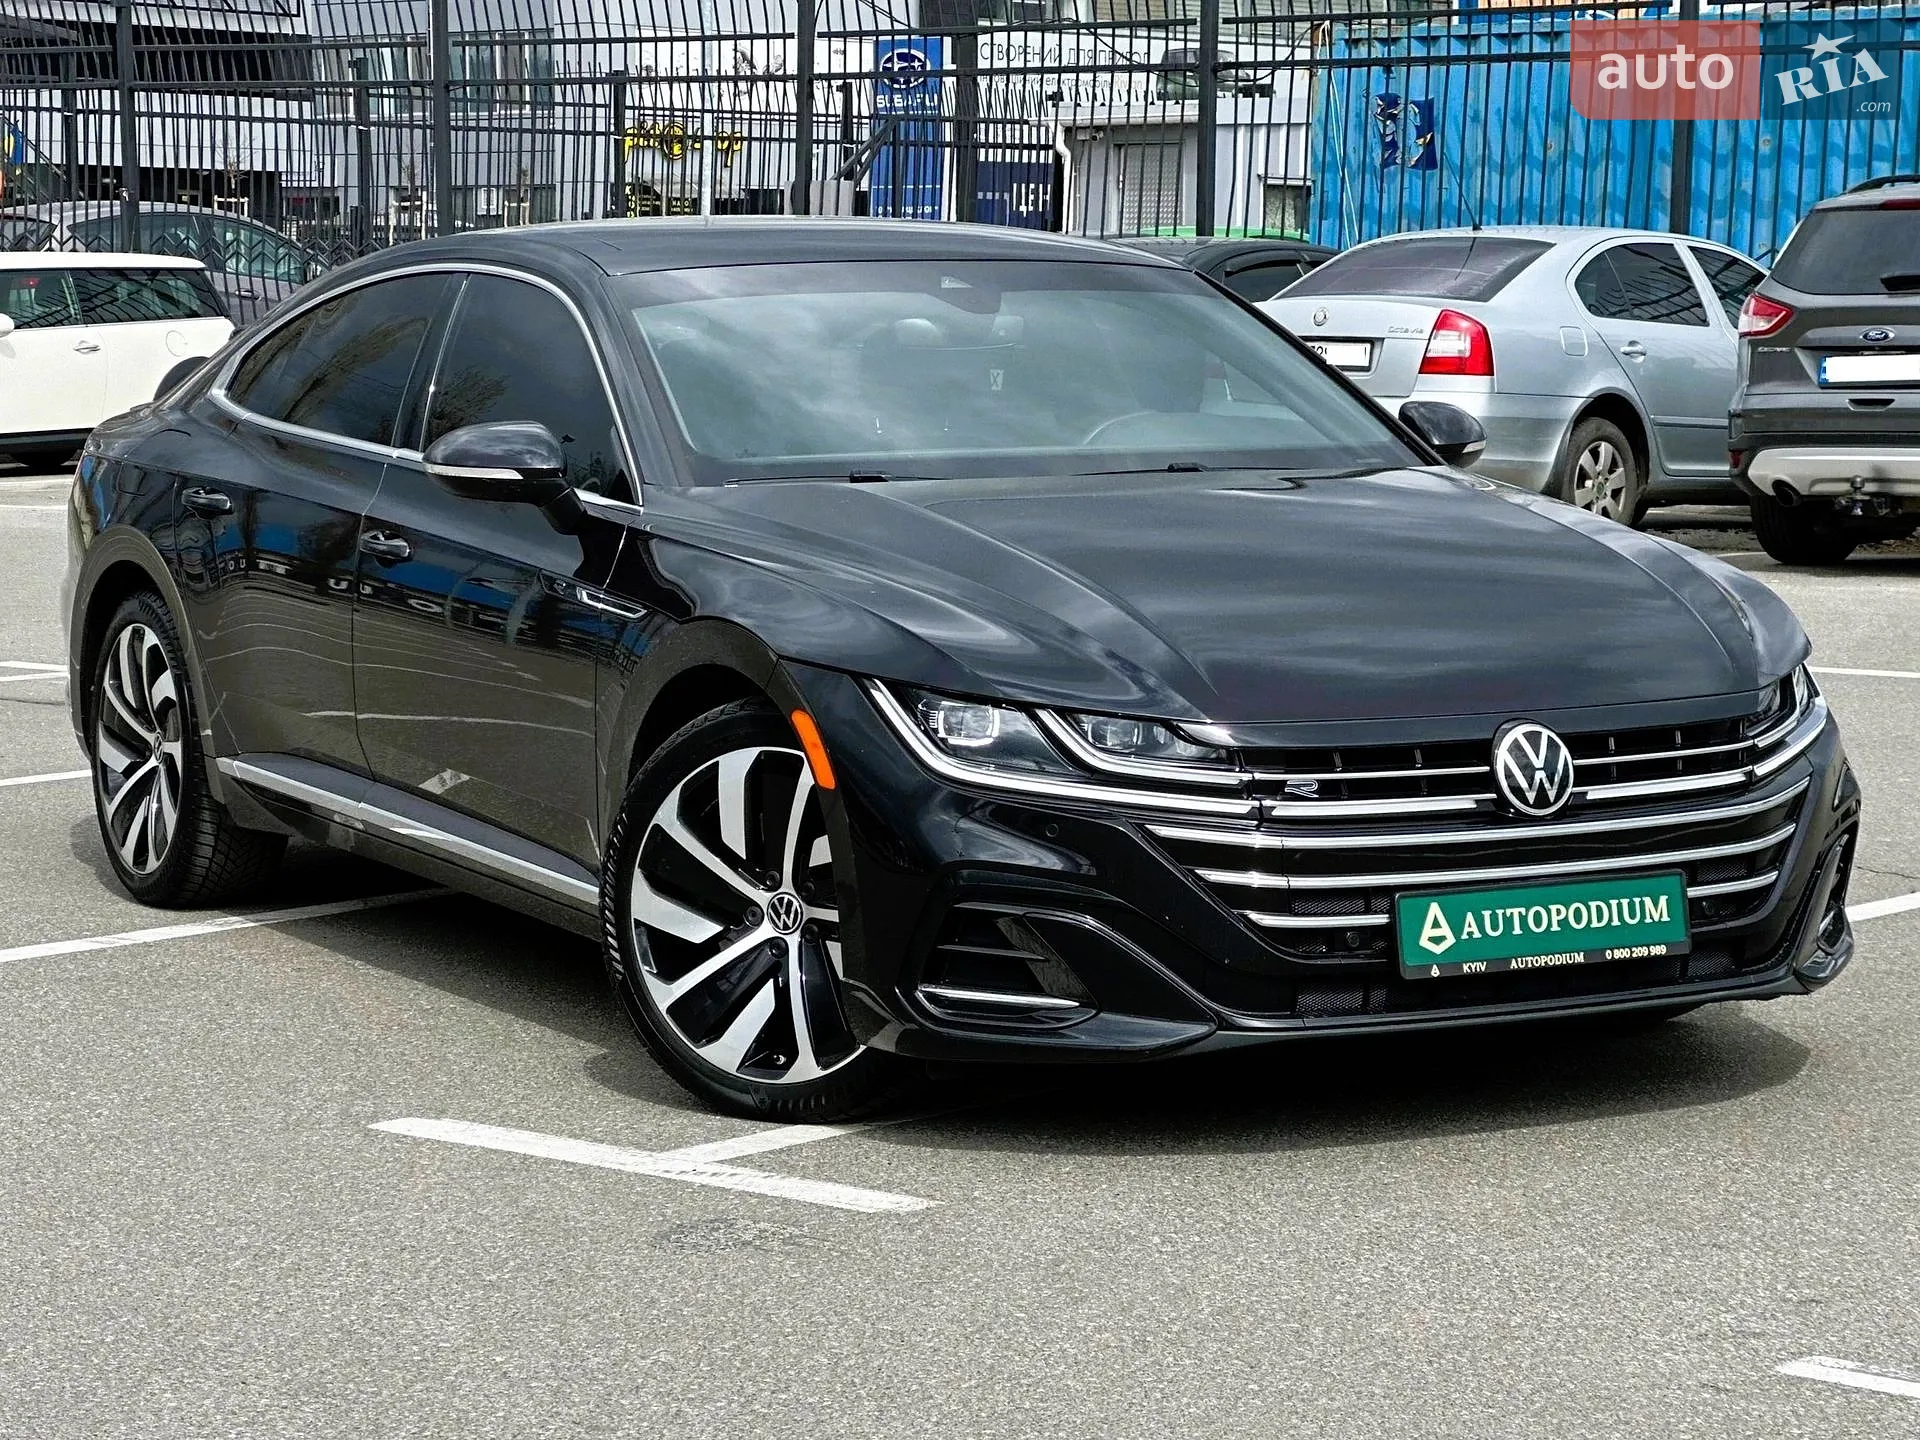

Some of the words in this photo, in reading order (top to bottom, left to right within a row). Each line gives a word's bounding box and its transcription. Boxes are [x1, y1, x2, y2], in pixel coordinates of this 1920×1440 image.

[1115, 75, 1142, 89] Rivan
[1461, 895, 1670, 940] AUTOPODIUM
[1463, 961, 1487, 973] KYIV
[1510, 952, 1585, 970] AUTOPODIUM
[1605, 949, 1613, 960] 0
[1613, 948, 1631, 959] 800
[1631, 946, 1649, 958] 209
[1650, 944, 1667, 956] 989
